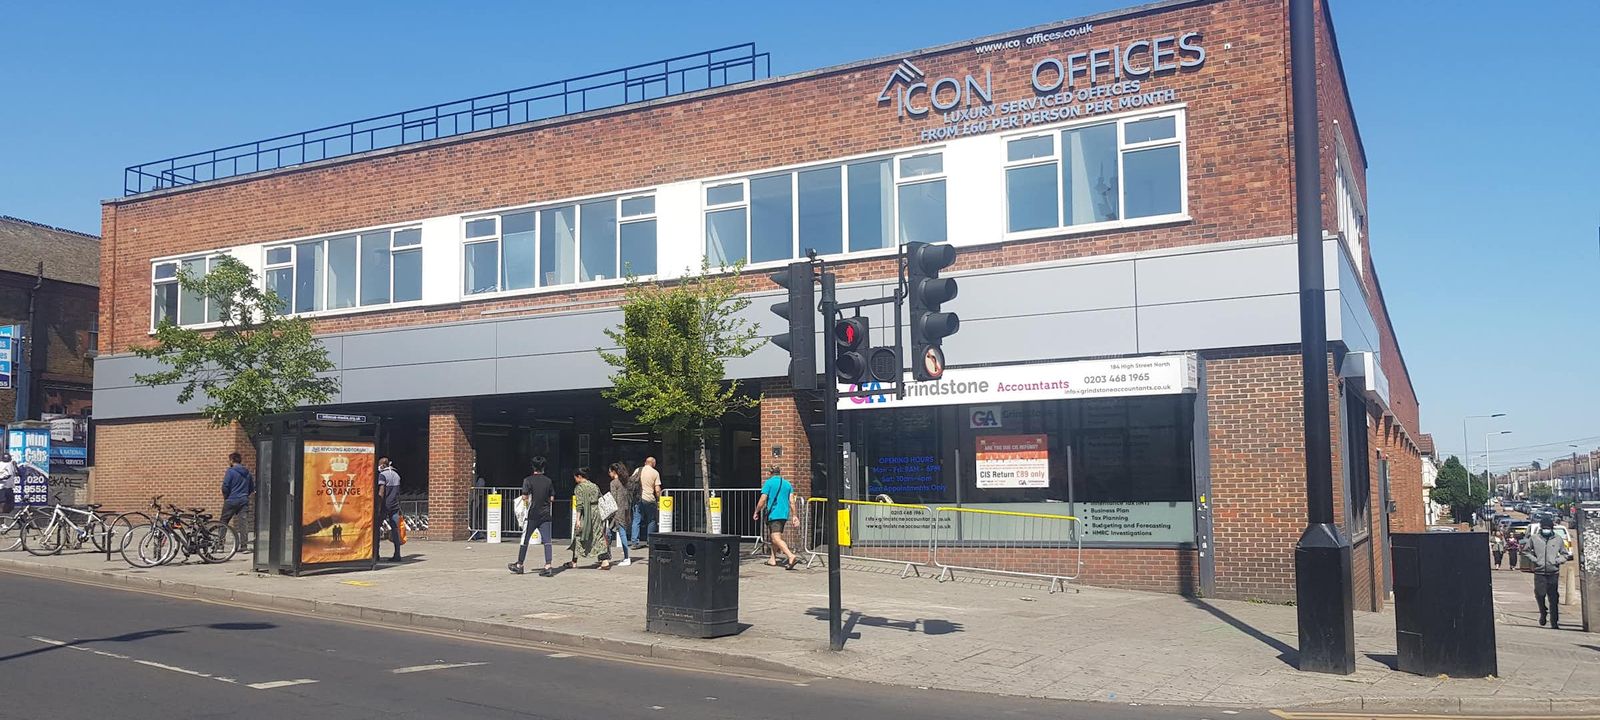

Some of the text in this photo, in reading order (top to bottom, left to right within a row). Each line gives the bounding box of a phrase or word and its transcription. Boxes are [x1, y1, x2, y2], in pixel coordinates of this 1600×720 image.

[897, 32, 1206, 117] ICON OFFICES
[943, 80, 1140, 124] LUXURY SERVICED OFFICES
[921, 89, 1175, 141] FROM £60 PER PERSON PER MONTH
[1084, 372, 1150, 384] 0203 468 1965
[901, 379, 1070, 398] rindstone Accountants
[972, 410, 998, 427] GA
[25, 434, 48, 447] Mini
[25, 448, 48, 462] Cabs
[27, 475, 45, 484] 020
[1016, 470, 1029, 478] £89
[1030, 470, 1045, 478] only
[321, 479, 356, 488] SOLDIER
[24, 494, 47, 502] 55
[326, 487, 361, 496] ORANGE
